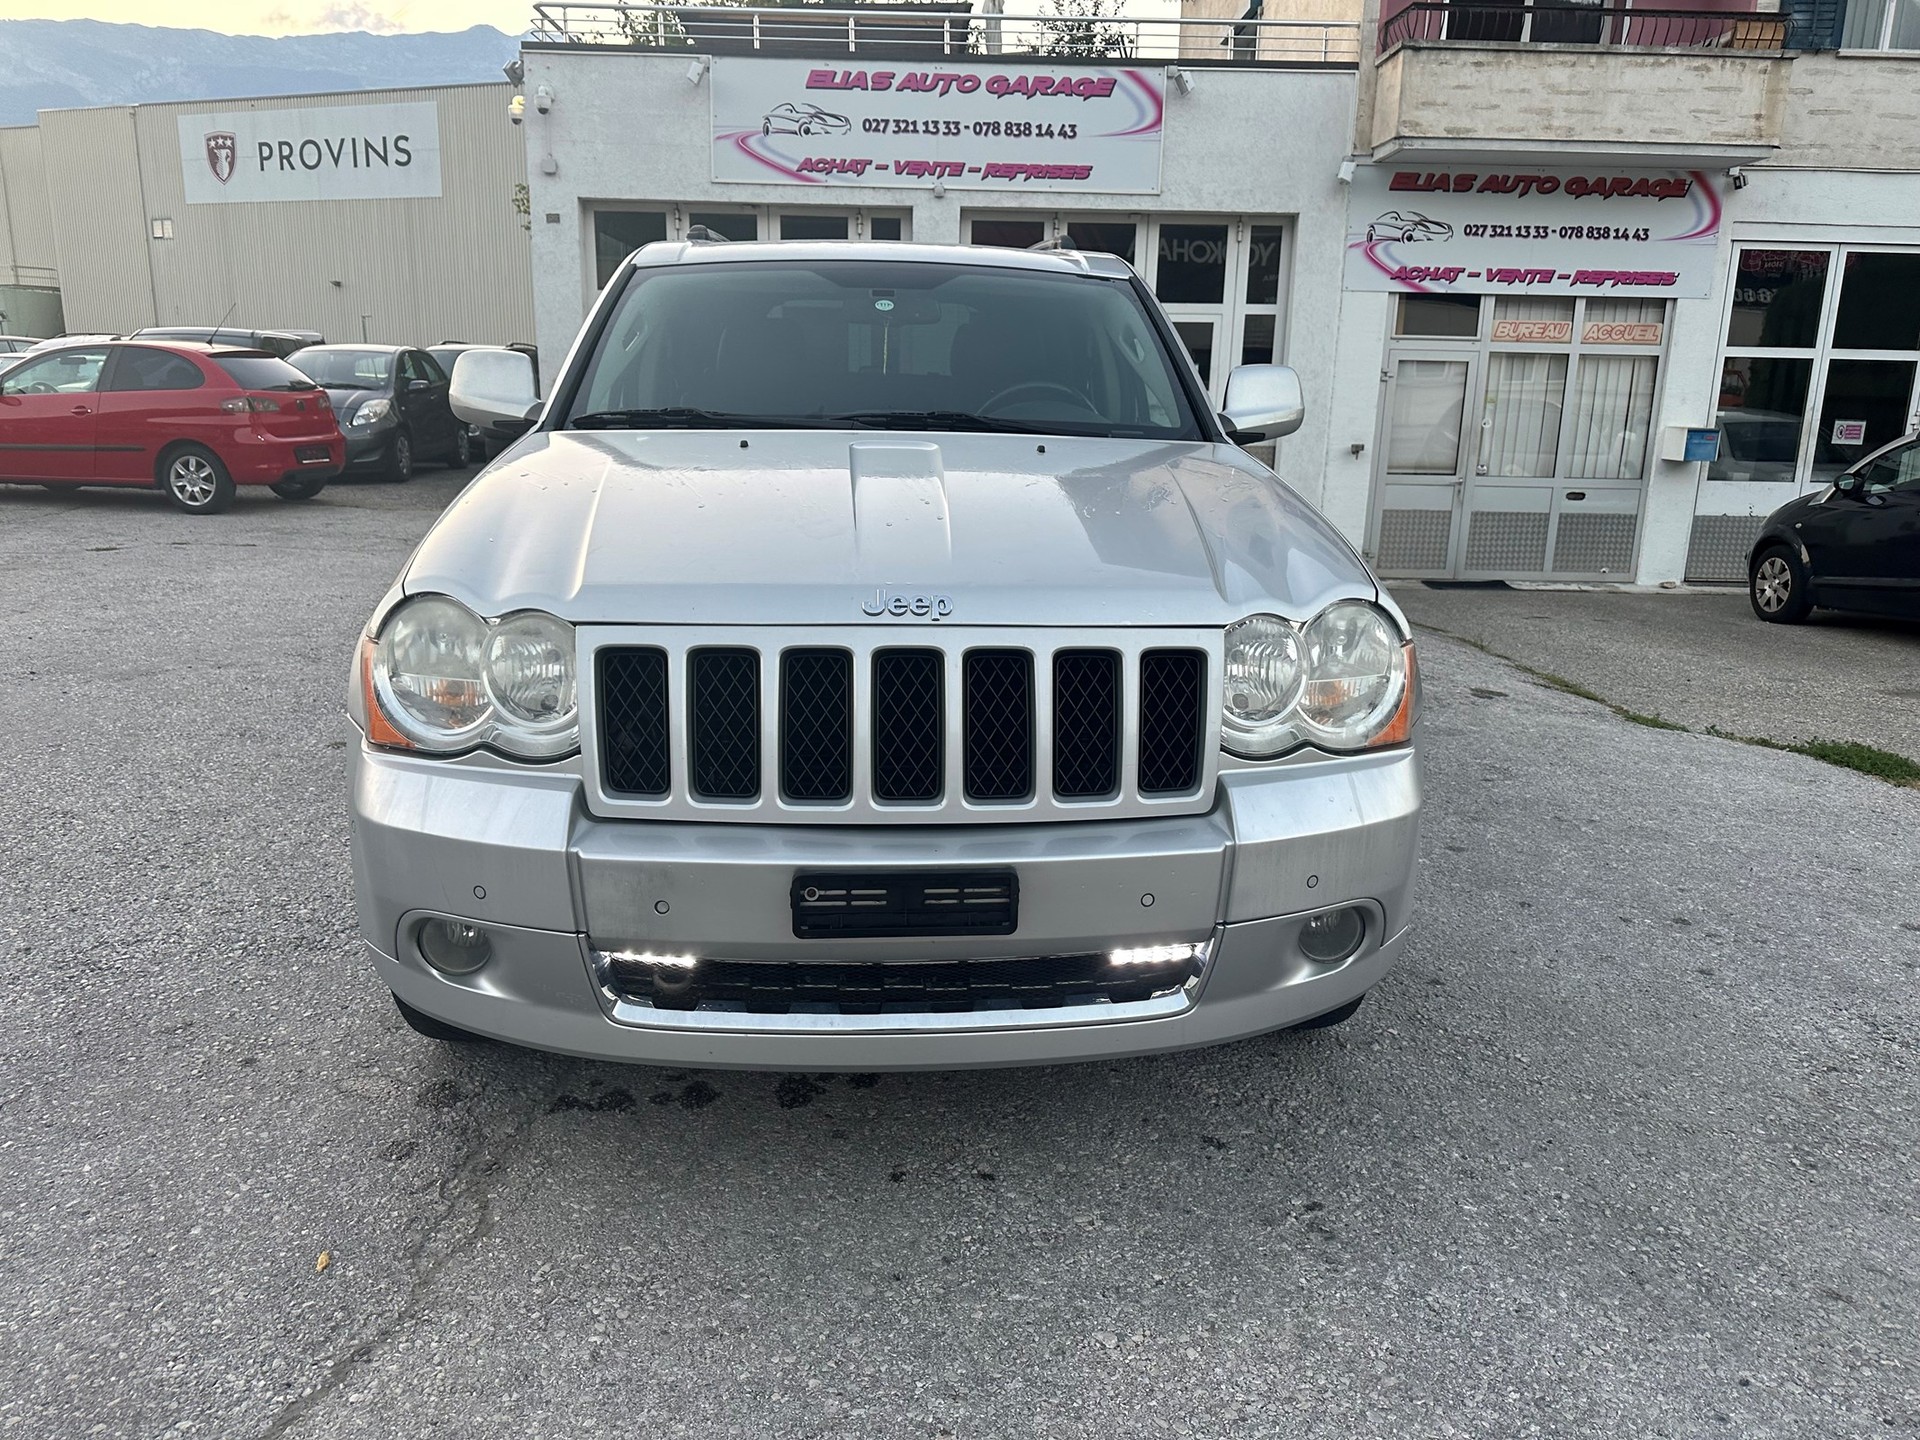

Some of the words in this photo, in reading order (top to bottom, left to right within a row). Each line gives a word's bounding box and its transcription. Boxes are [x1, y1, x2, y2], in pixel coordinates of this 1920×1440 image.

[805, 69, 896, 90] ELIAS
[896, 72, 981, 97] AUTO
[986, 74, 1117, 101] GARAGE
[862, 118, 890, 133] 027
[892, 119, 919, 134] 321
[922, 120, 940, 135] 13
[941, 120, 961, 135] 33
[973, 121, 1001, 137] 078
[1003, 122, 1032, 137] 838
[1035, 123, 1054, 138] 14
[1057, 123, 1077, 139] 43
[258, 135, 412, 172] PROVINS
[796, 157, 873, 176] ACHAT
[893, 160, 965, 178] VENTE
[981, 162, 1093, 182] REPRISES
[1389, 172, 1476, 193] ELIAS
[1476, 175, 1560, 198] AUTO
[1564, 176, 1693, 201] GARAGE
[1464, 224, 1487, 238] 027
[1488, 224, 1513, 238] 321
[1515, 226, 1531, 239] 13
[1532, 226, 1549, 239] 33
[1558, 226, 1583, 239] 078
[1585, 227, 1611, 240] 838
[1613, 228, 1631, 241] 14
[1632, 228, 1649, 242] 43
[1391, 266, 1466, 284] ACHAT
[1486, 268, 1556, 286] VENTE
[1570, 270, 1680, 288] REPRISES
[1494, 322, 1570, 342] BUREAU
[861, 589, 954, 622] Jeep
